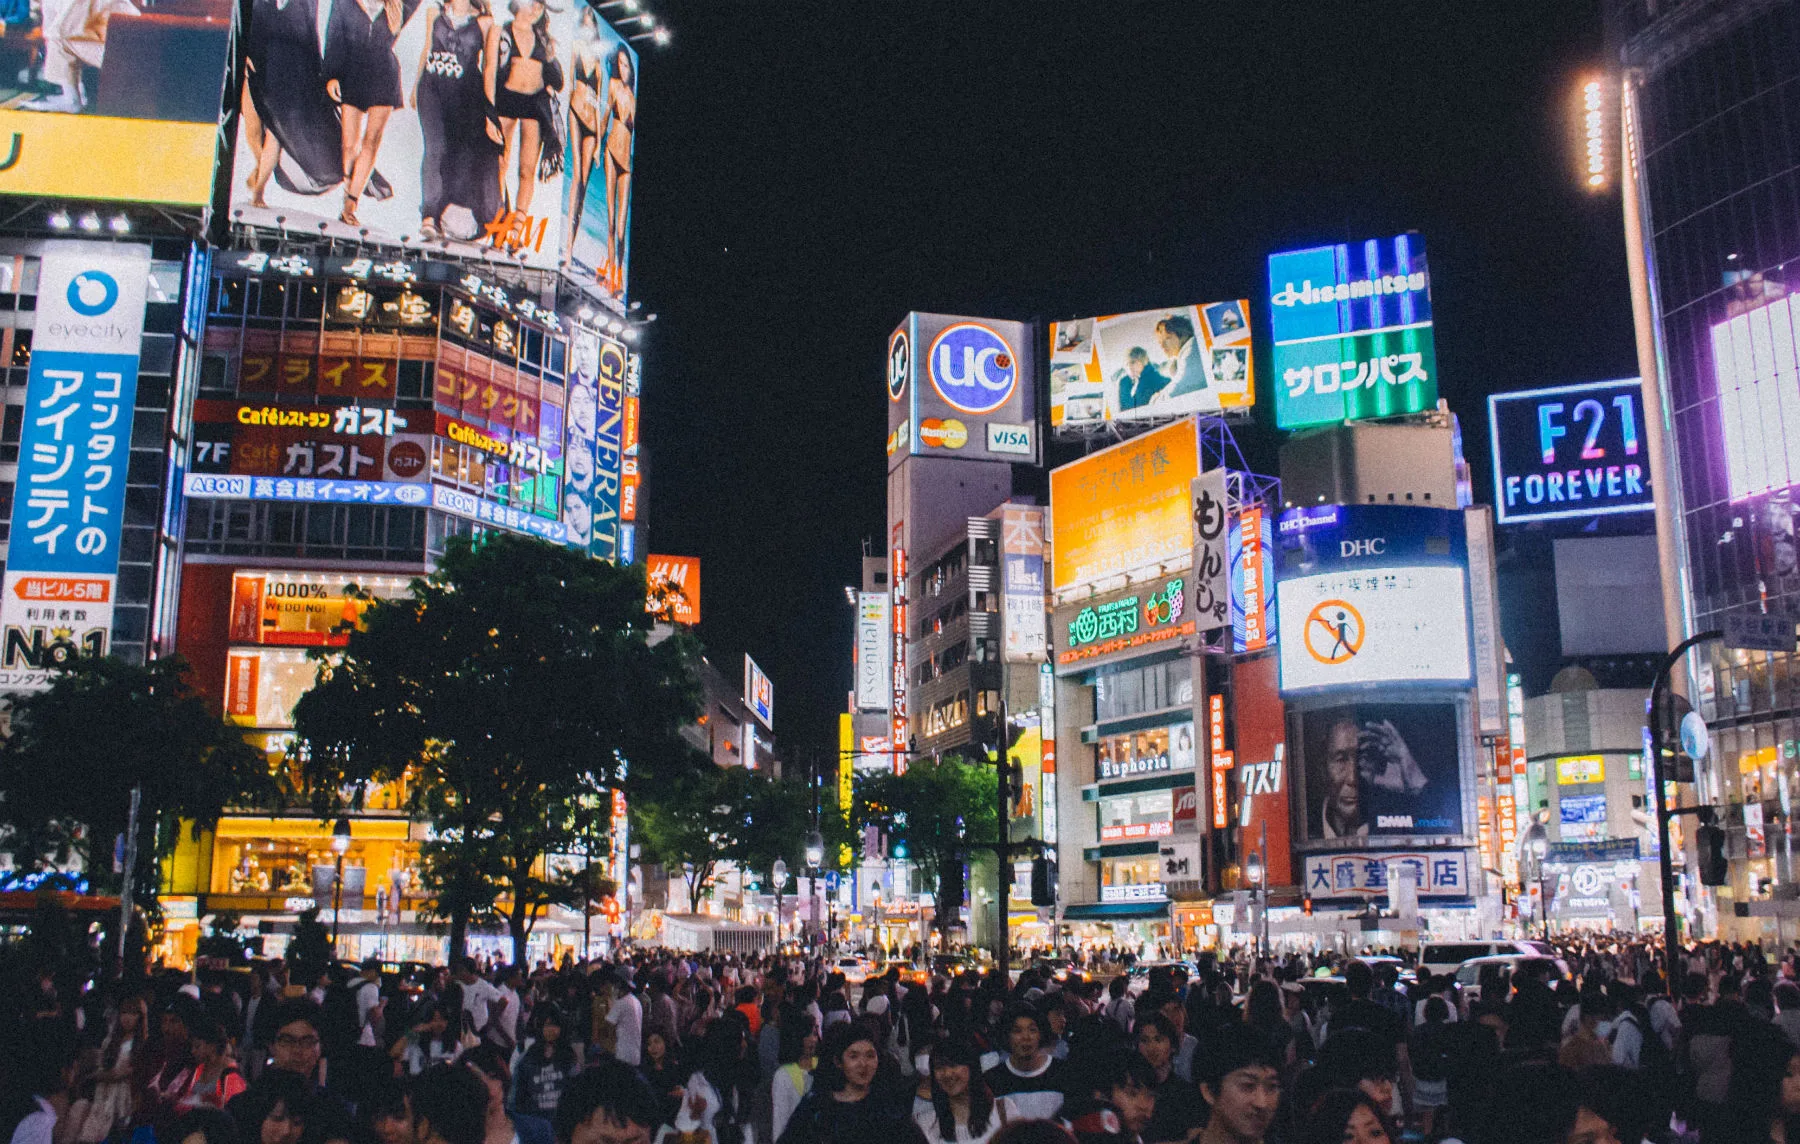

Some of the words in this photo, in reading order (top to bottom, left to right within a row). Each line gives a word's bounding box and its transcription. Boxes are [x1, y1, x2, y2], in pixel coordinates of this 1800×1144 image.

[1271, 272, 1425, 307] Hisamitsu
[49, 322, 128, 343] eyecity
[1283, 352, 1428, 398] サロンパス
[437, 369, 536, 426] コンタクト
[333, 406, 408, 436] ガスト
[993, 431, 1029, 446] VISA
[1538, 394, 1638, 464] F21
[27, 369, 84, 555] アイシティ
[76, 371, 122, 555] コンタクトの
[196, 441, 231, 464] 7F
[284, 441, 375, 478] ガスト
[508, 440, 555, 475] ガスト
[190, 477, 245, 494] AEON
[254, 479, 391, 501] 英会話イーオン
[1506, 463, 1643, 507] FOREVER
[437, 490, 475, 514] AEON
[478, 502, 567, 540] 英会話イーオン
[1280, 519, 1299, 532] DHC
[1300, 513, 1337, 530] Channel
[1193, 489, 1228, 623] もんじゃ
[1340, 537, 1387, 558] DHC
[267, 583, 328, 598] 1000%
[1099, 606, 1139, 639] 西村
[1102, 754, 1169, 778] Euphoria
